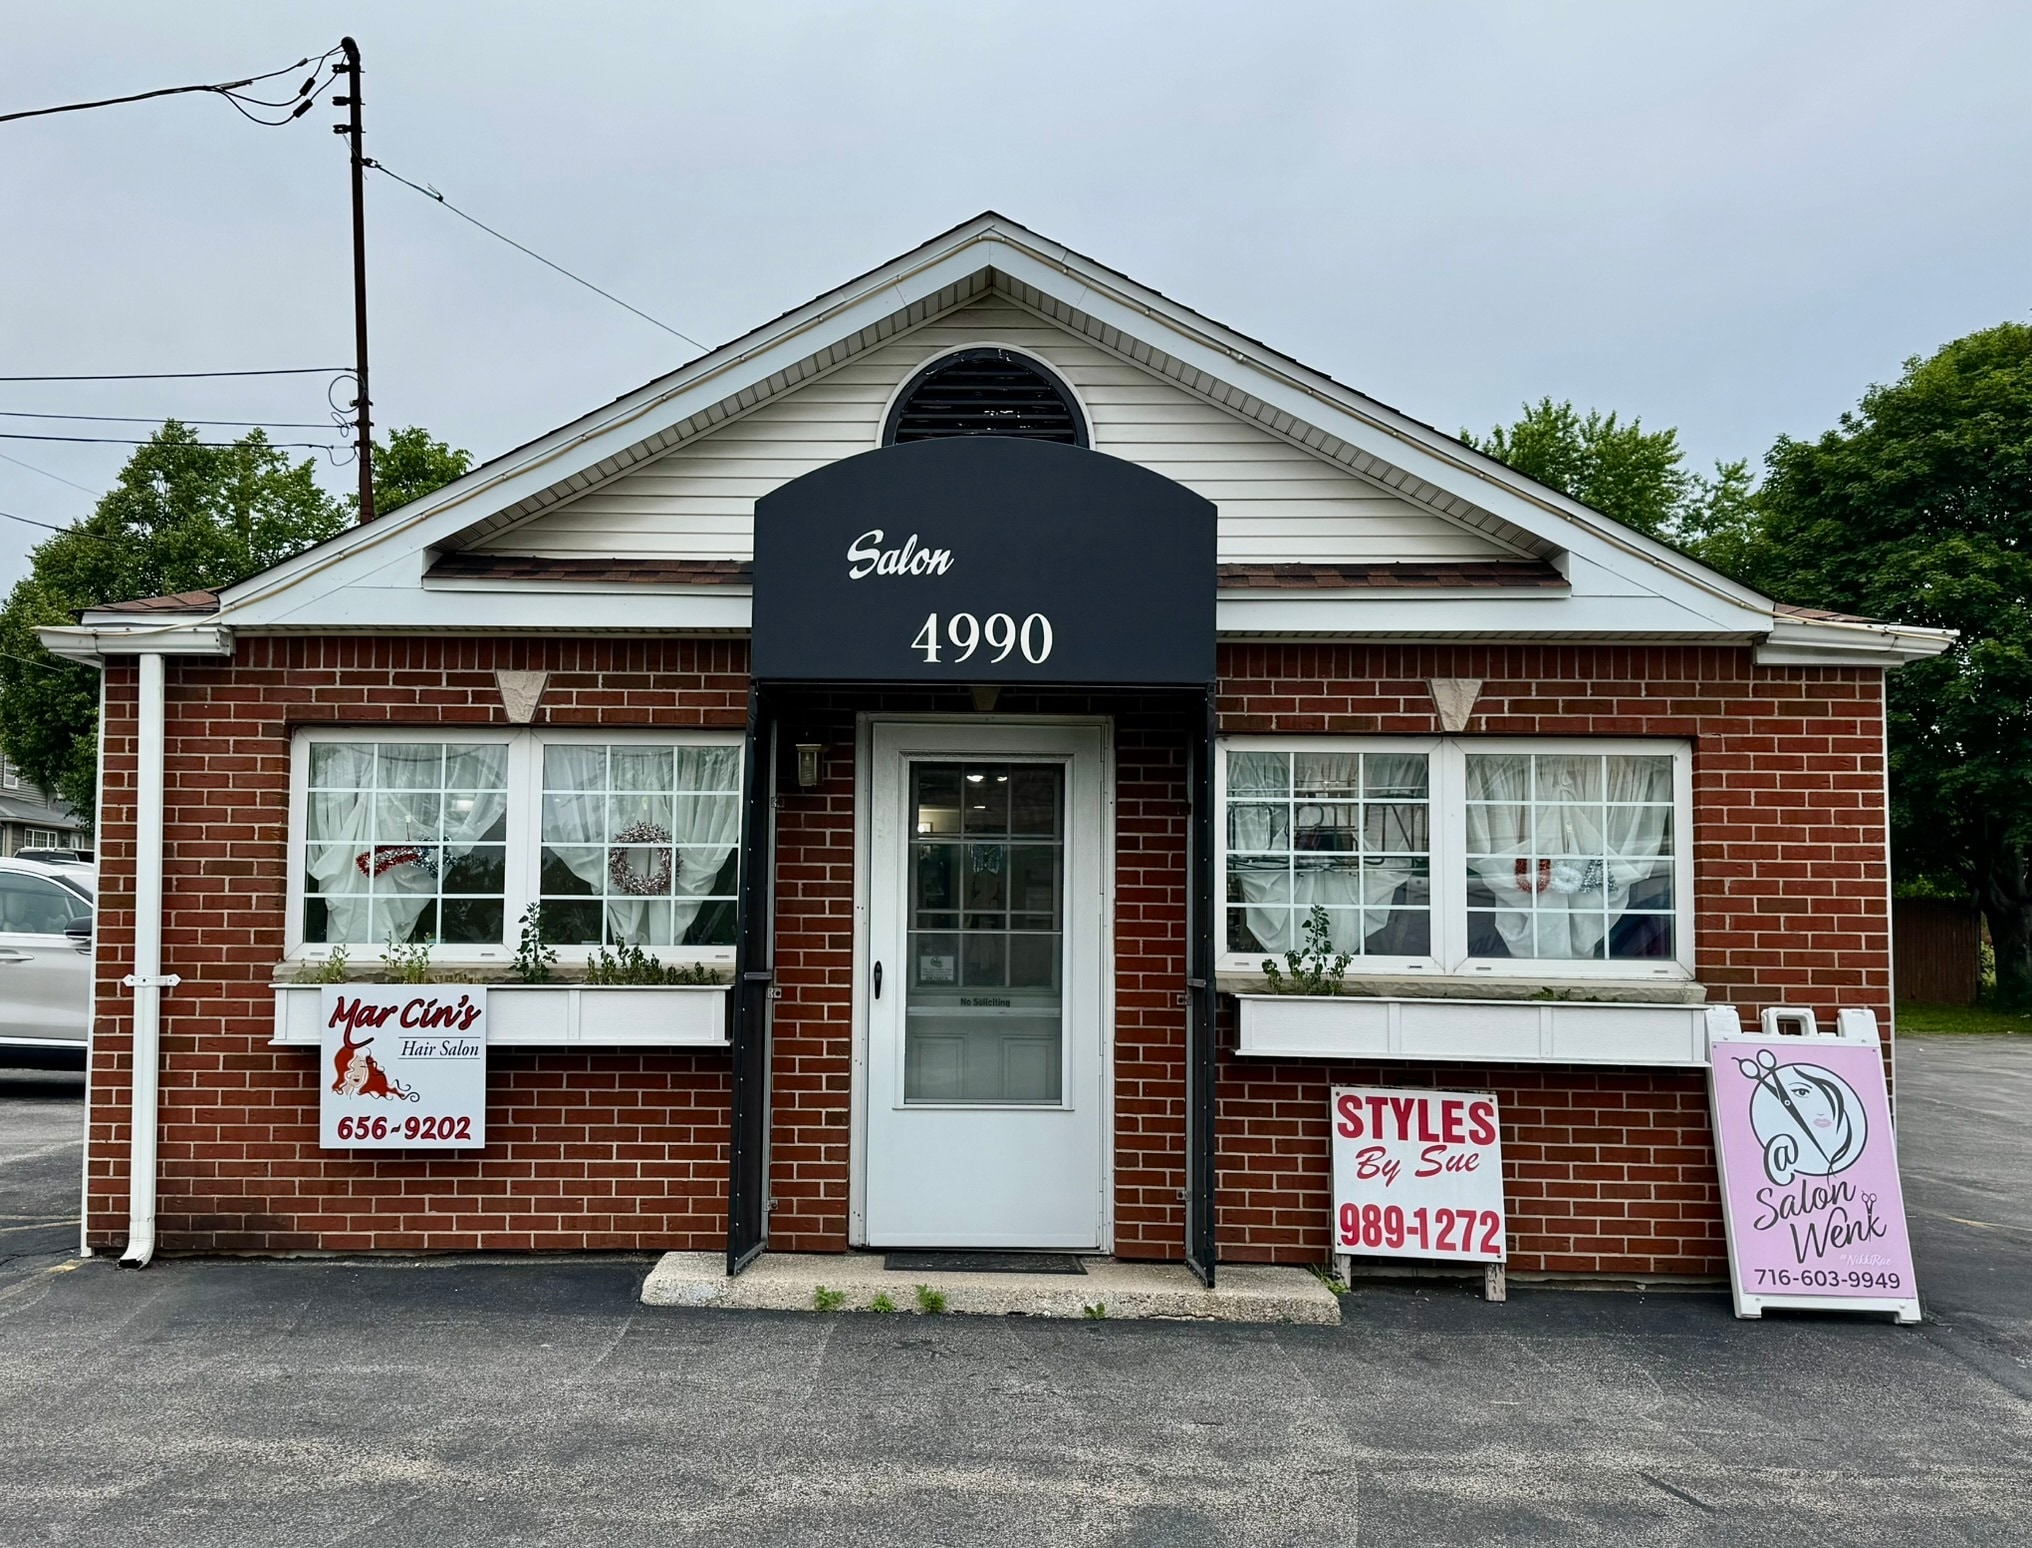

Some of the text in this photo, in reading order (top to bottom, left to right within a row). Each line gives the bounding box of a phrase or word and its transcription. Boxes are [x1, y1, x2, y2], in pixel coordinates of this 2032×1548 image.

[846, 528, 955, 580] Salon
[910, 612, 1053, 664] 4990
[960, 997, 1011, 1008] No Soliciting
[400, 1039, 479, 1057] Hair Salon
[337, 1115, 471, 1141] 656-9202
[1336, 1094, 1496, 1146] STYLES
[1355, 1144, 1480, 1187] By Sue
[1762, 1133, 1800, 1187] @
[1339, 1202, 1502, 1255] 989-1272
[1753, 1177, 1857, 1232] Salon
[1789, 1206, 1888, 1264] Wenk
[1753, 1268, 1901, 1290] 716-603-9949
